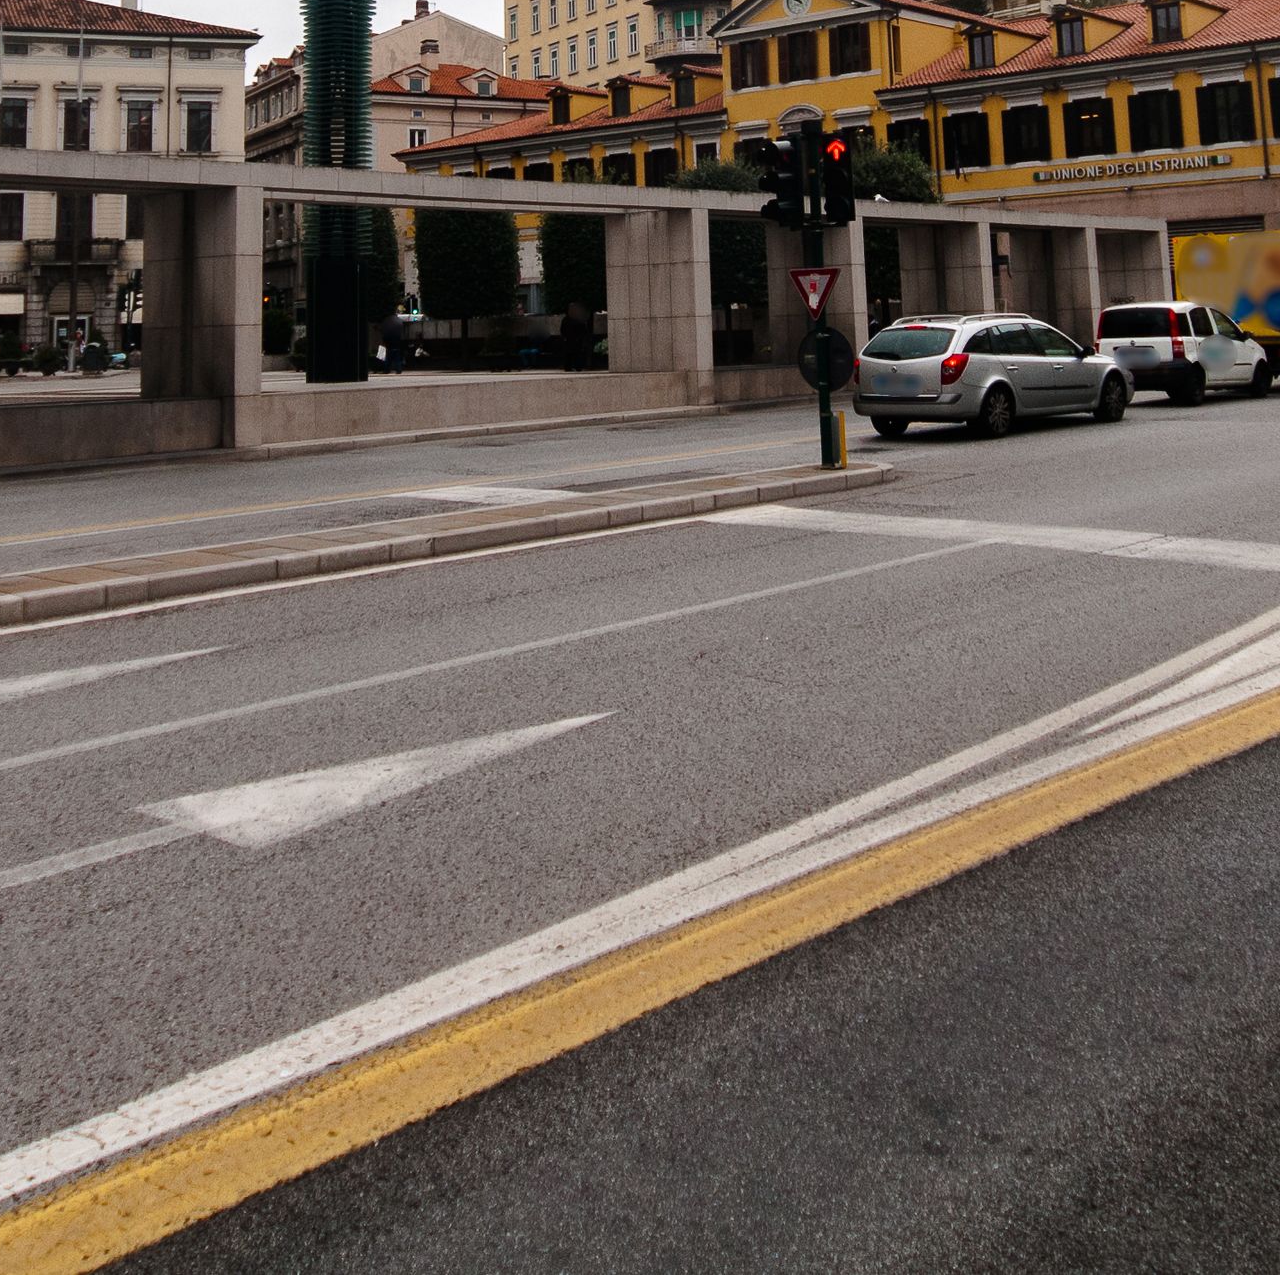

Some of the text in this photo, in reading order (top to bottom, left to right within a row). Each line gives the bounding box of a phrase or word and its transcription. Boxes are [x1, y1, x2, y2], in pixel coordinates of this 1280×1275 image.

[1053, 154, 1209, 181] UNIONE DEGLI ISTRIANI
